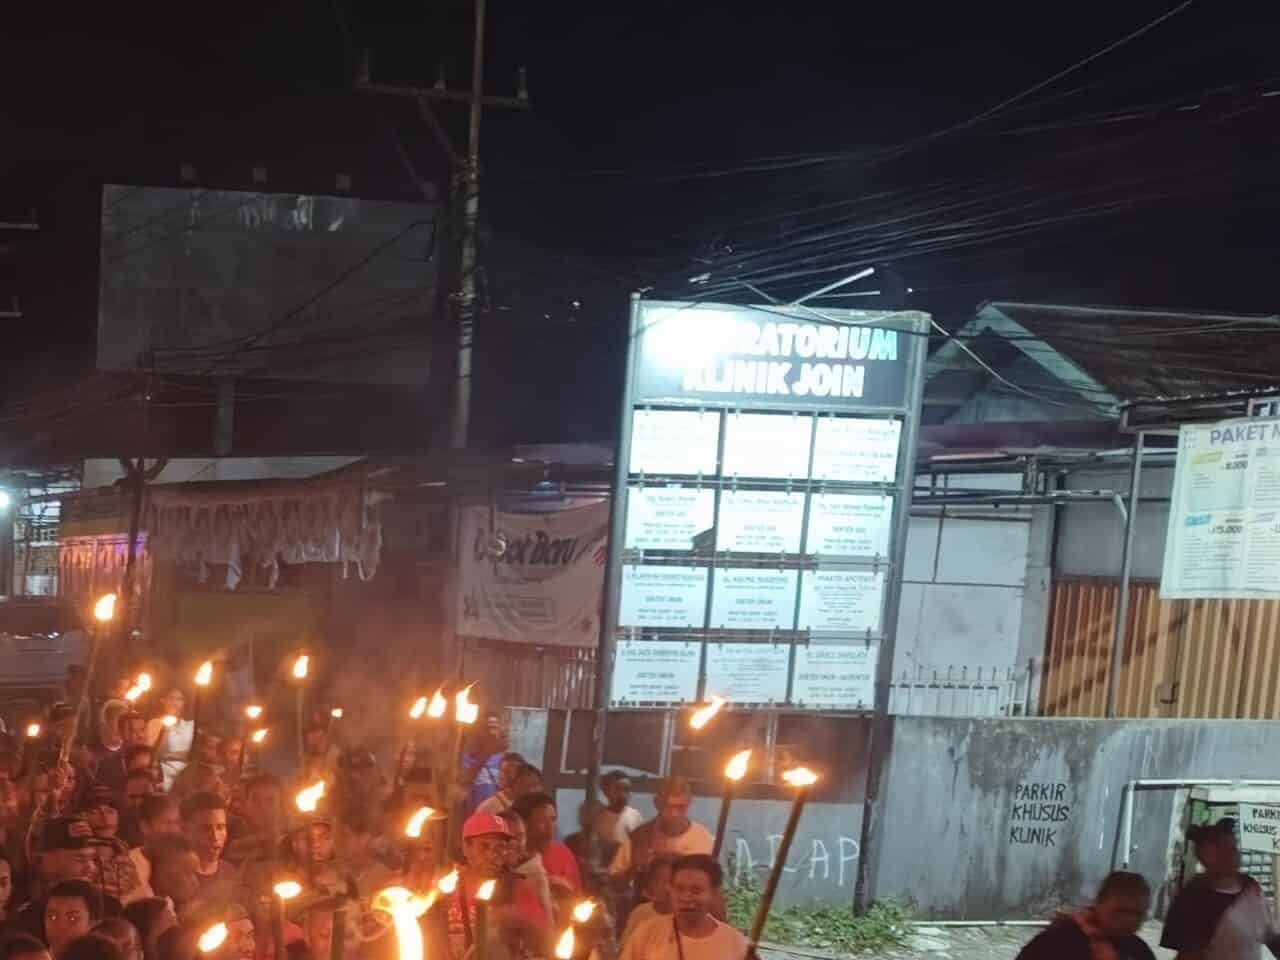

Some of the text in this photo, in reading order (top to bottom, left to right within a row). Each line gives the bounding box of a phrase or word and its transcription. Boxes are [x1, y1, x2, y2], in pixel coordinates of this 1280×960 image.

[682, 358, 865, 398] KLINIK JOIN
[1210, 423, 1267, 446] PAKET
[1015, 782, 1066, 801] PARKIR
[1011, 803, 1070, 822] KHUSUS
[1008, 824, 1057, 848] KLINIK
